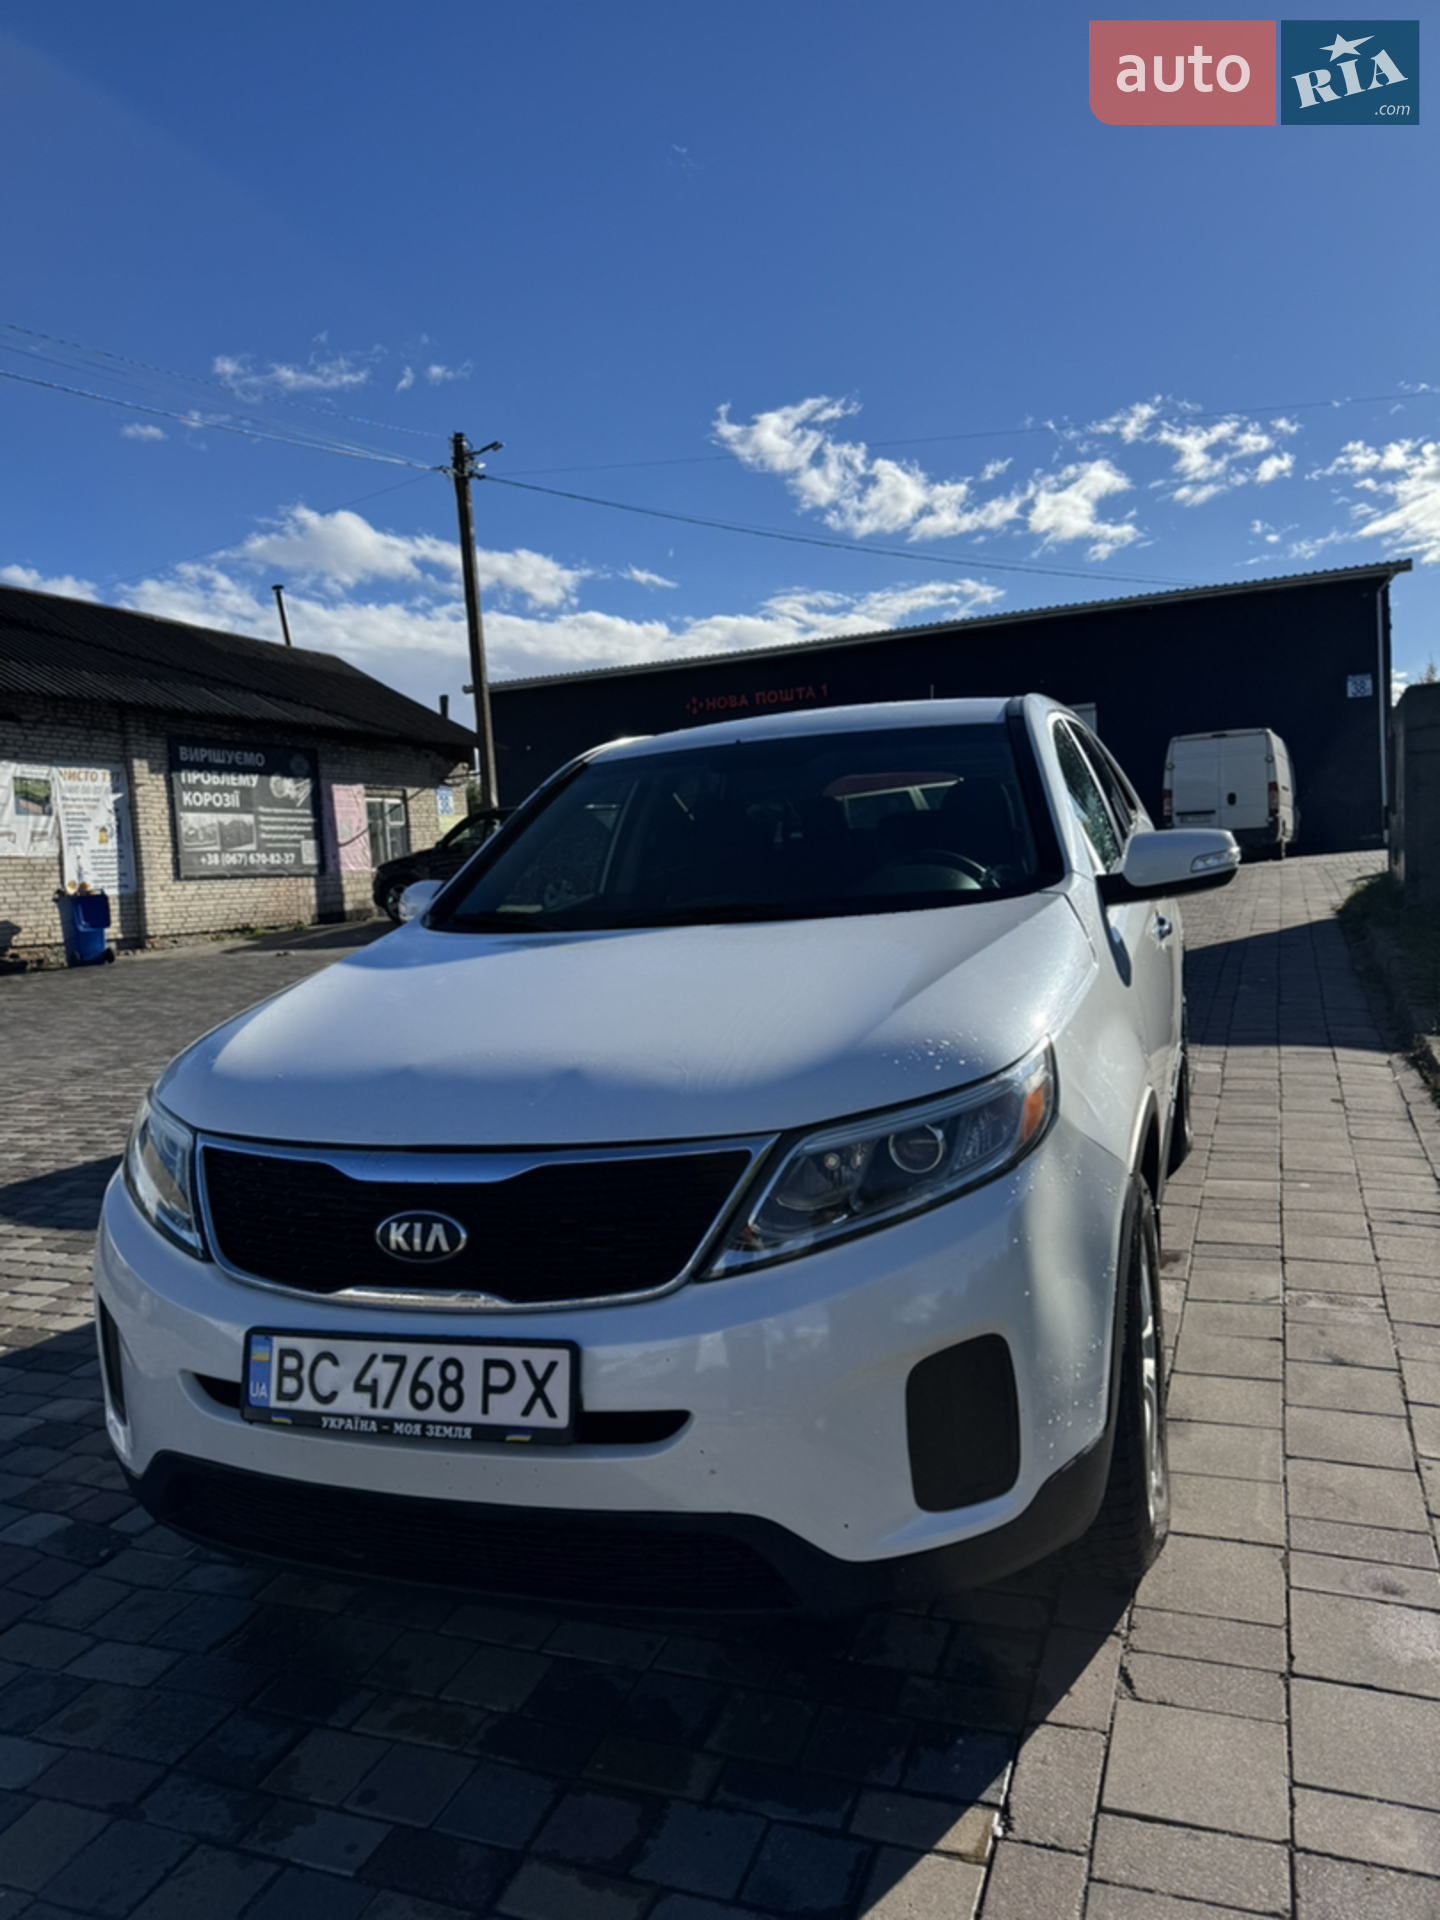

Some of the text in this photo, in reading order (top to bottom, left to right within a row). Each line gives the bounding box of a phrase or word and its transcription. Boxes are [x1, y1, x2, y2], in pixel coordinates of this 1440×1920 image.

[705, 684, 828, 711] НОВА ПОШТА 1
[179, 746, 266, 767] ВИРІШУЄМО
[181, 768, 259, 788] ПРОБЛЕМУ
[182, 789, 241, 808] КОРОЗІЇ
[200, 852, 219, 865] +38
[221, 852, 248, 867] (067)
[388, 1222, 451, 1252] KIA
[249, 1381, 268, 1399] UA
[276, 1347, 560, 1420] BC 4768 PX
[320, 1416, 378, 1434] УКРАЇНА
[393, 1421, 422, 1436] МОЯ
[425, 1424, 473, 1439] ЗЕМЛЯ
